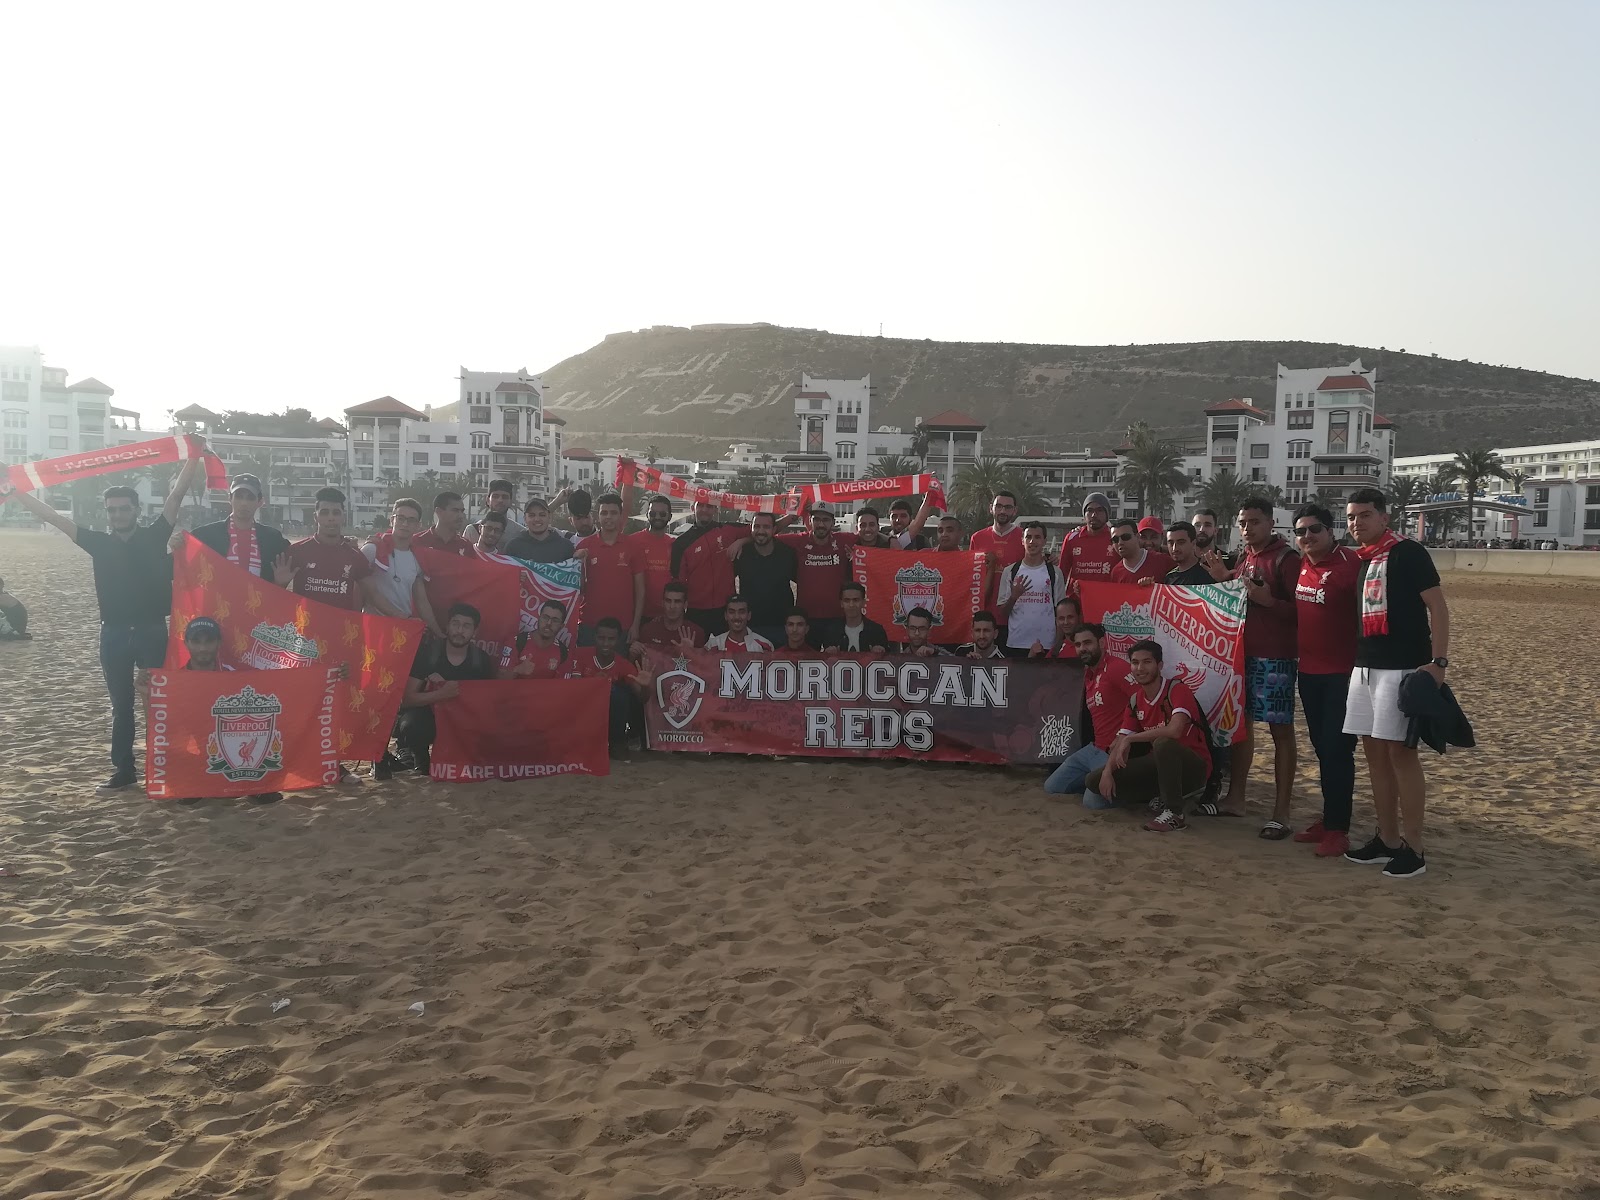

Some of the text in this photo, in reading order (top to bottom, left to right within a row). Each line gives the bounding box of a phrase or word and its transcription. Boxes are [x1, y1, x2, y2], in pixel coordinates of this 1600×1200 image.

[832, 478, 901, 494] LIVERPOOL
[804, 559, 833, 567] Chartered
[807, 553, 832, 561] Standard
[855, 549, 867, 567] FC
[304, 584, 339, 594] Chartered
[306, 576, 340, 586] Standard
[969, 551, 987, 618] Liverpoo
[902, 587, 935, 595] LIVERPOOL
[1206, 586, 1230, 609] WALK
[1158, 594, 1237, 662] LIVERPOOL
[1158, 619, 1229, 676] FOOTBALL CLUB
[718, 658, 1009, 708] MOROCCAN
[221, 721, 270, 731] LIVERPOOL
[317, 667, 342, 783] Liverpool FC
[803, 706, 934, 752] REDS
[149, 674, 170, 796] Liverpool FC
[658, 733, 704, 744] MOROCCO
[430, 762, 457, 779] WE
[460, 765, 494, 779] ARE
